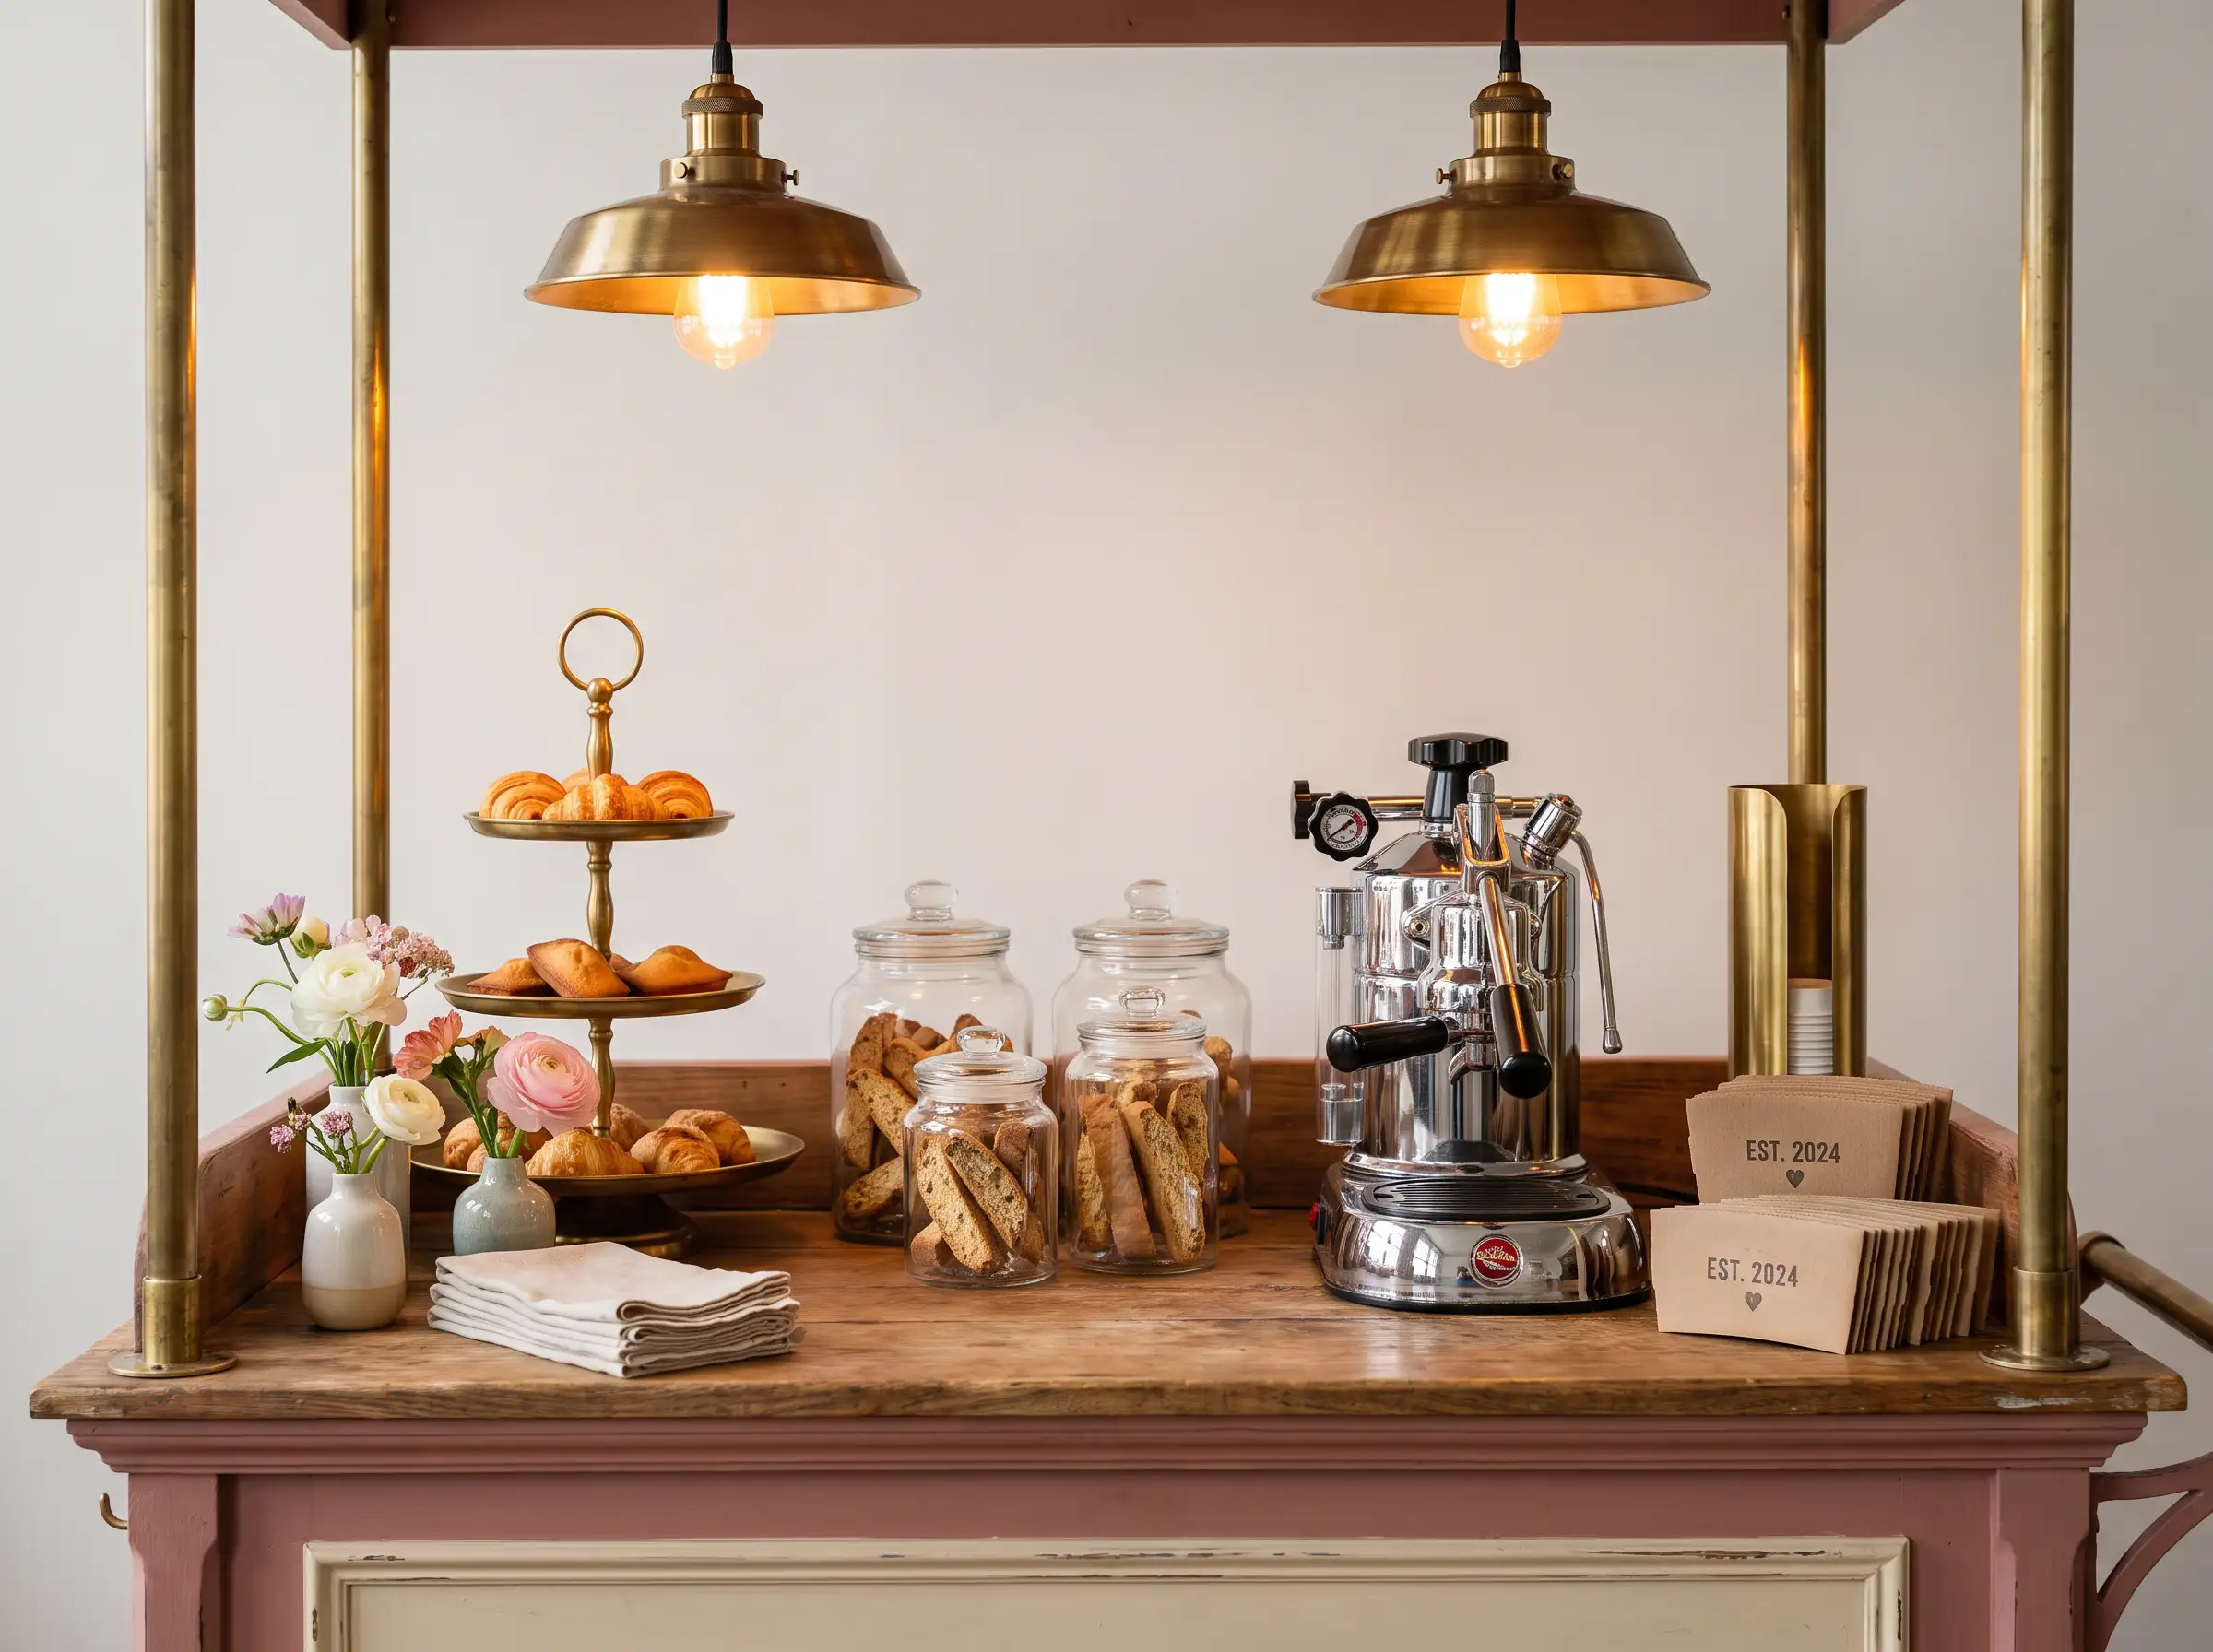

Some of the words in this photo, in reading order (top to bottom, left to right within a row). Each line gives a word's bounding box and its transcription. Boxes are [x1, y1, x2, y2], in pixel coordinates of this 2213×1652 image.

[1746, 1139, 1785, 1162] EST.
[1792, 1140, 1841, 1164] 2024
[1707, 1257, 1745, 1282] EST.
[1751, 1261, 1799, 1288] 2024
